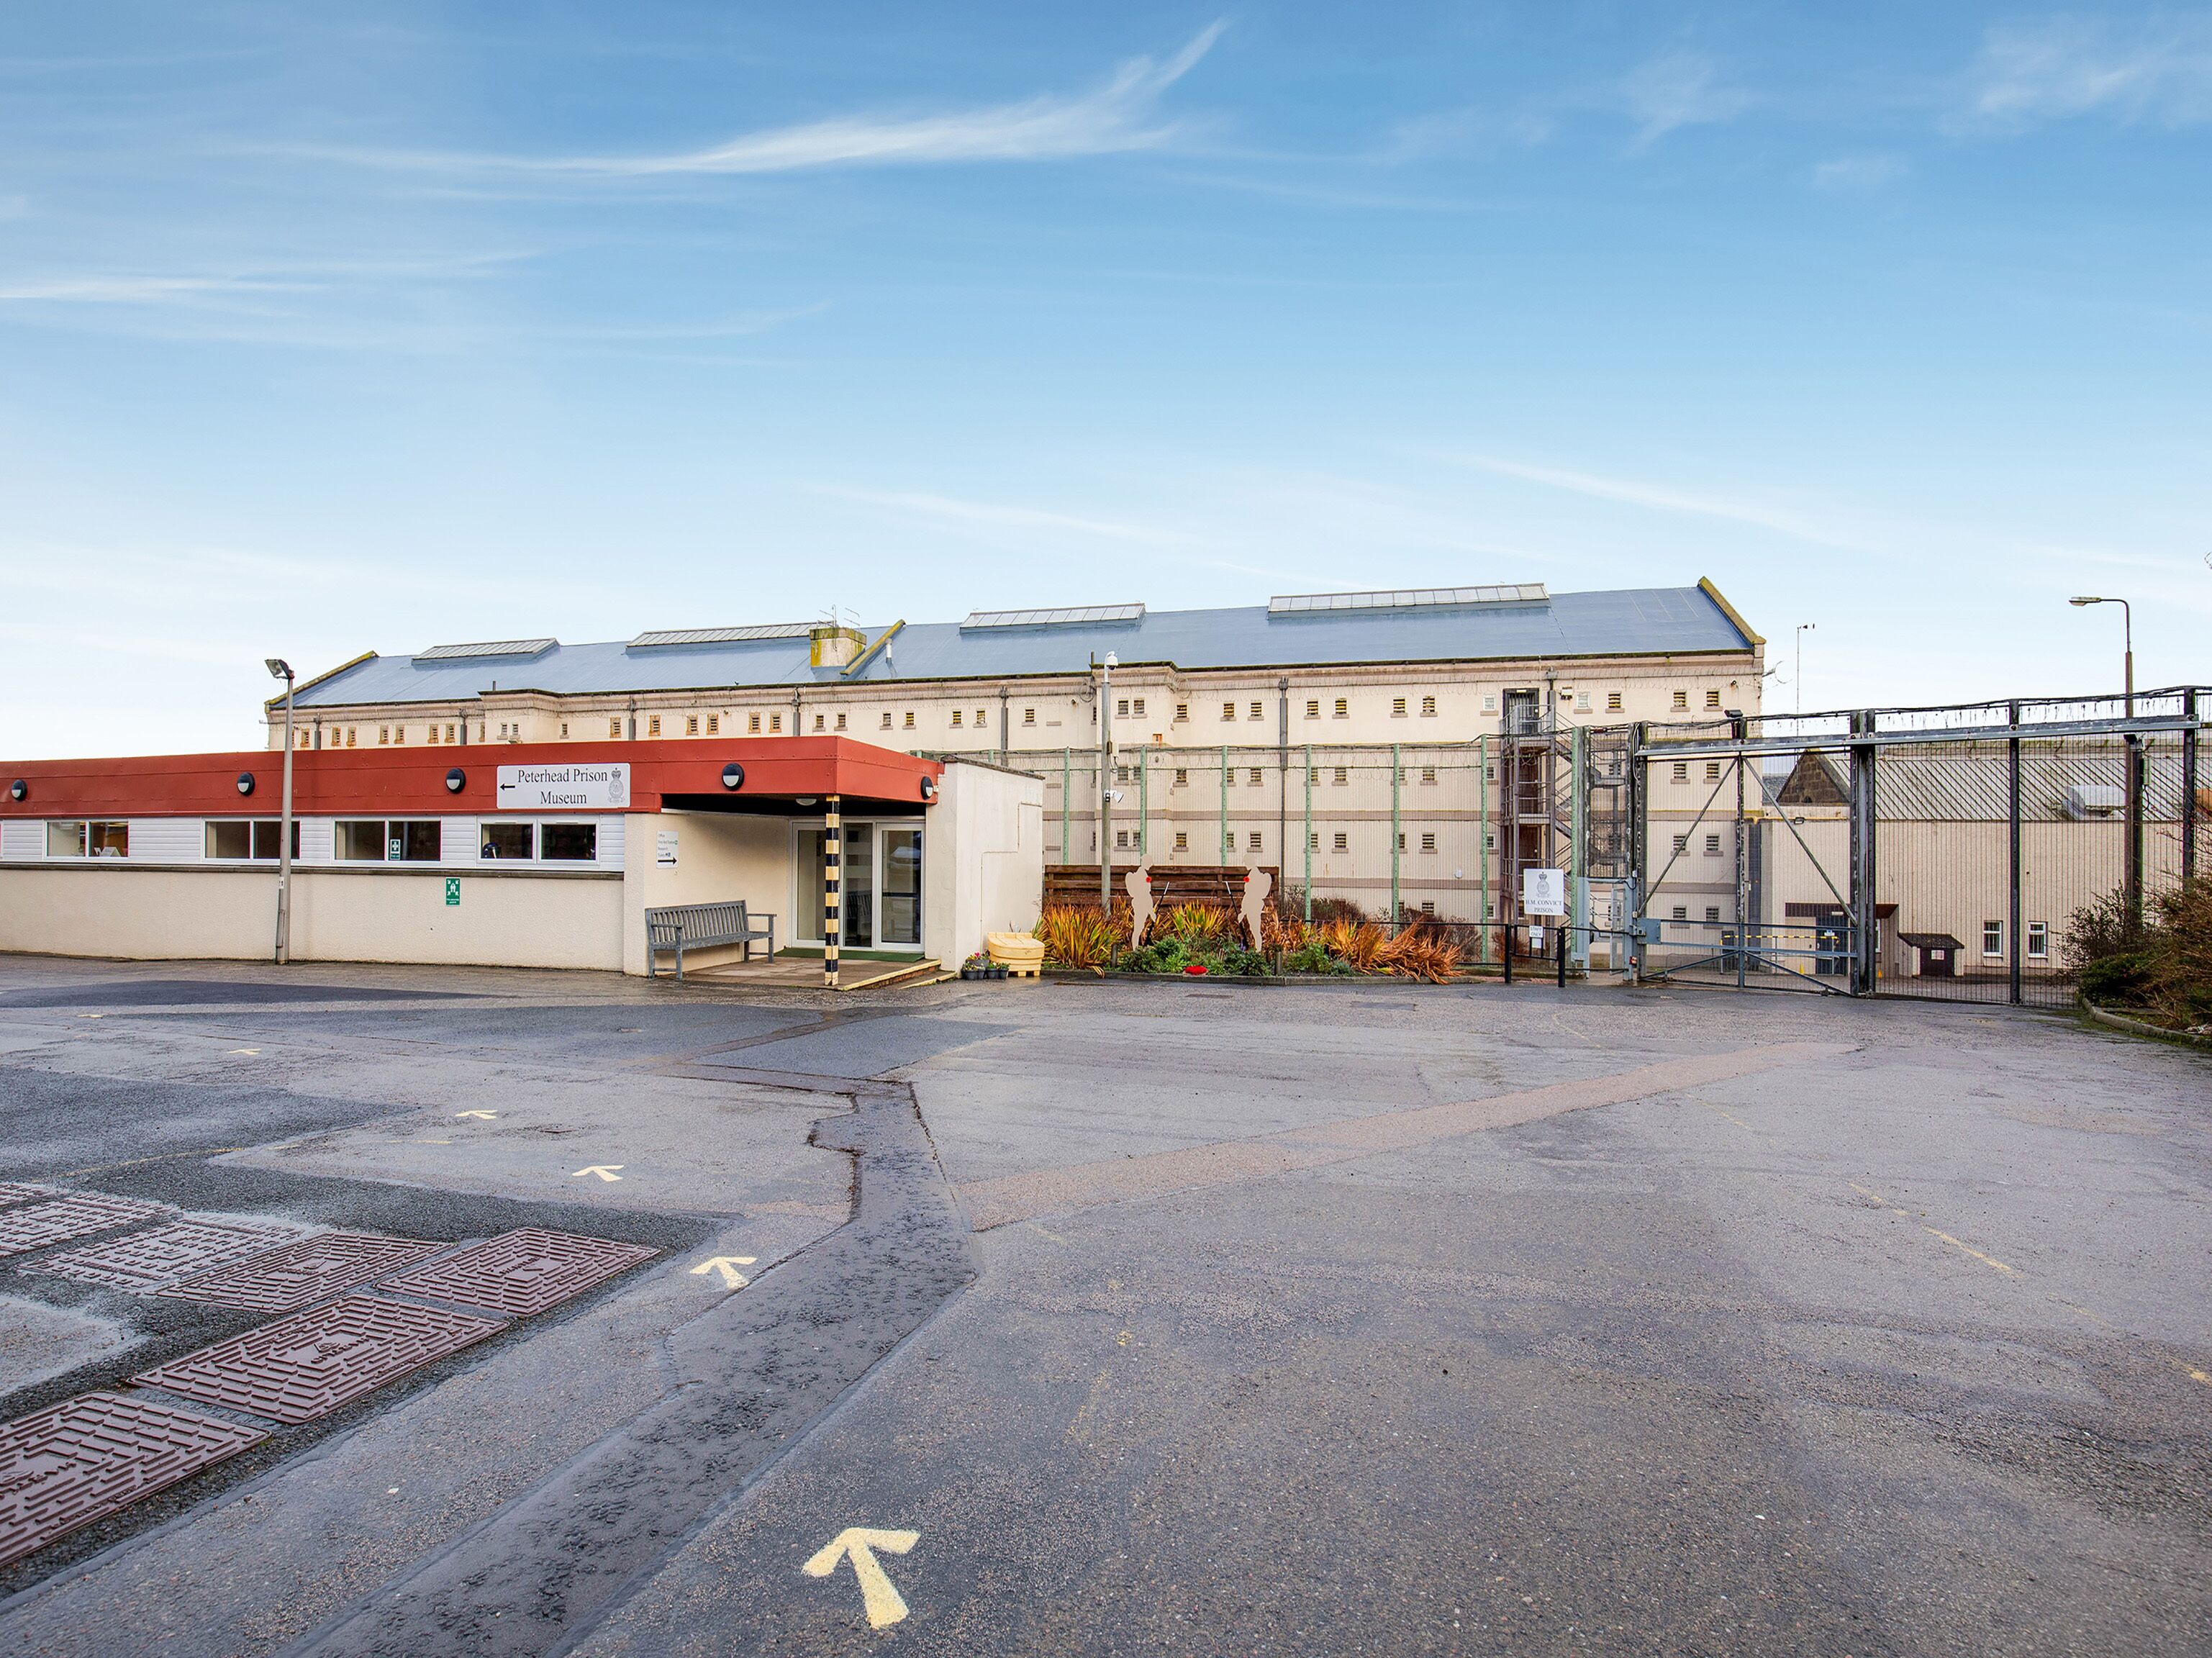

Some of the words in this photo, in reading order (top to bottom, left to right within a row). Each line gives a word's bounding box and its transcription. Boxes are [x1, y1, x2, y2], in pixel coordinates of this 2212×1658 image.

[517, 769, 569, 783] Peterhead
[574, 768, 607, 782] Prison
[540, 791, 587, 805] Museum
